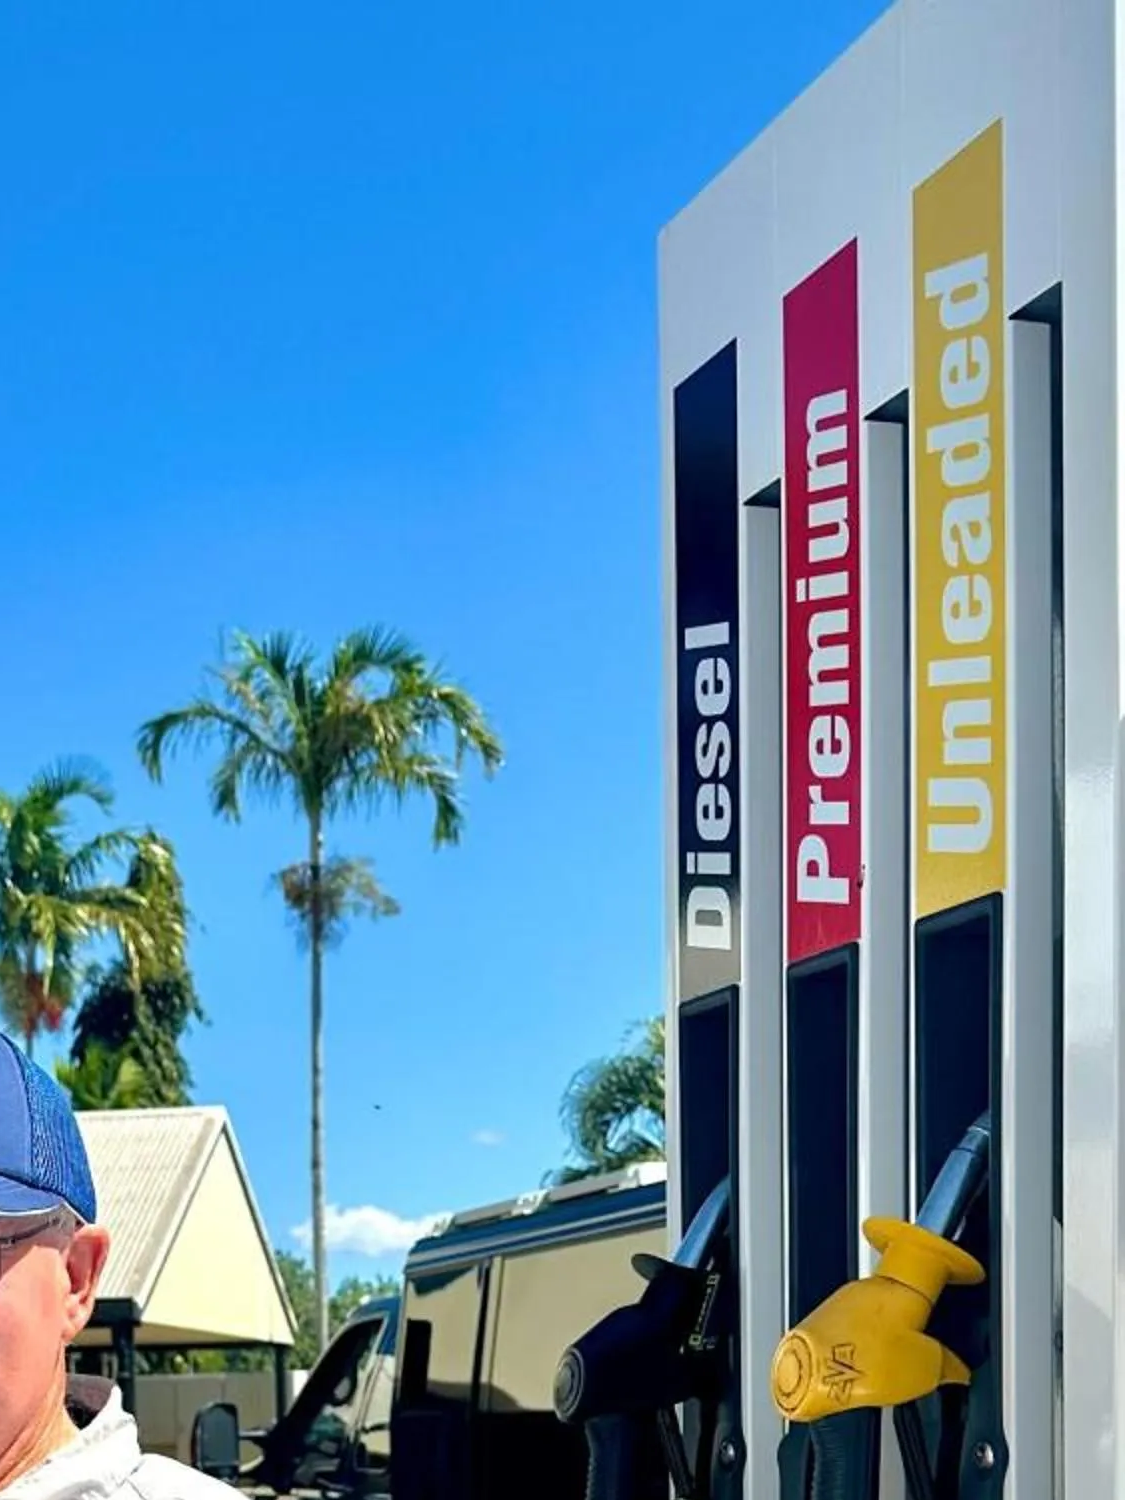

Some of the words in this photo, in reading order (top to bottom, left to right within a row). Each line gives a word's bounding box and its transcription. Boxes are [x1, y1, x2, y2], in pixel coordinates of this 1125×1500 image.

[684, 621, 732, 951] Diesel
[796, 387, 850, 906] Premium
[925, 251, 992, 855] Unleaded
